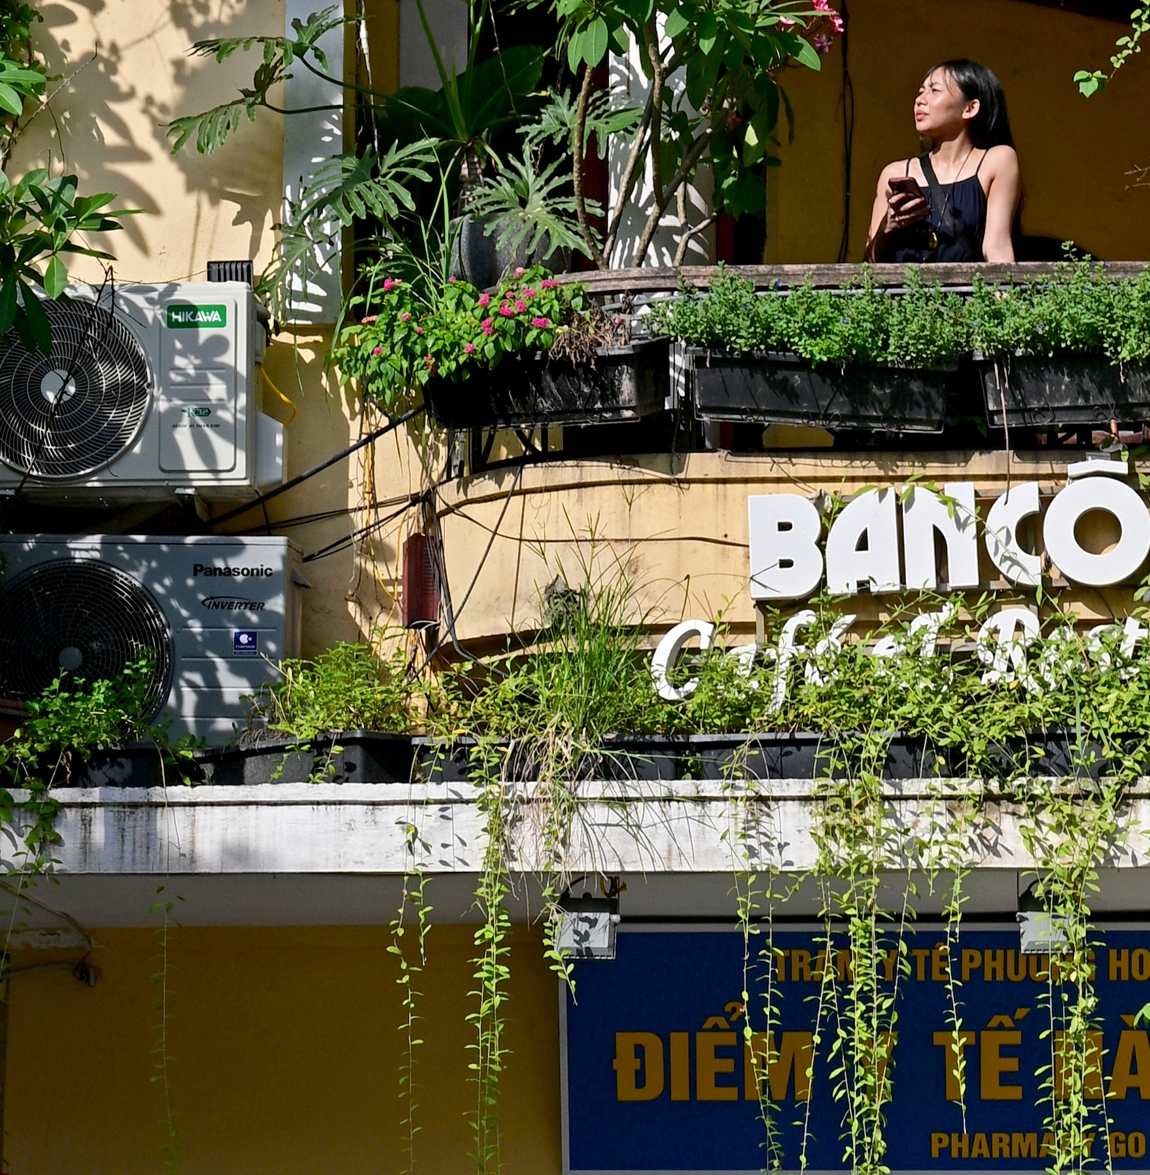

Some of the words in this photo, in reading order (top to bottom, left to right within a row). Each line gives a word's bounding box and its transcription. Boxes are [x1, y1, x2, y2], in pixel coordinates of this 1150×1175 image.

[171, 310, 222, 323] HIKAWA
[193, 564, 273, 577] Panasonic
[206, 600, 266, 611] INVERTER
[612, 1001, 814, 1102] ĐIỂM
[932, 1007, 1031, 1101] TẾ
[1108, 1131, 1147, 1159] GO
